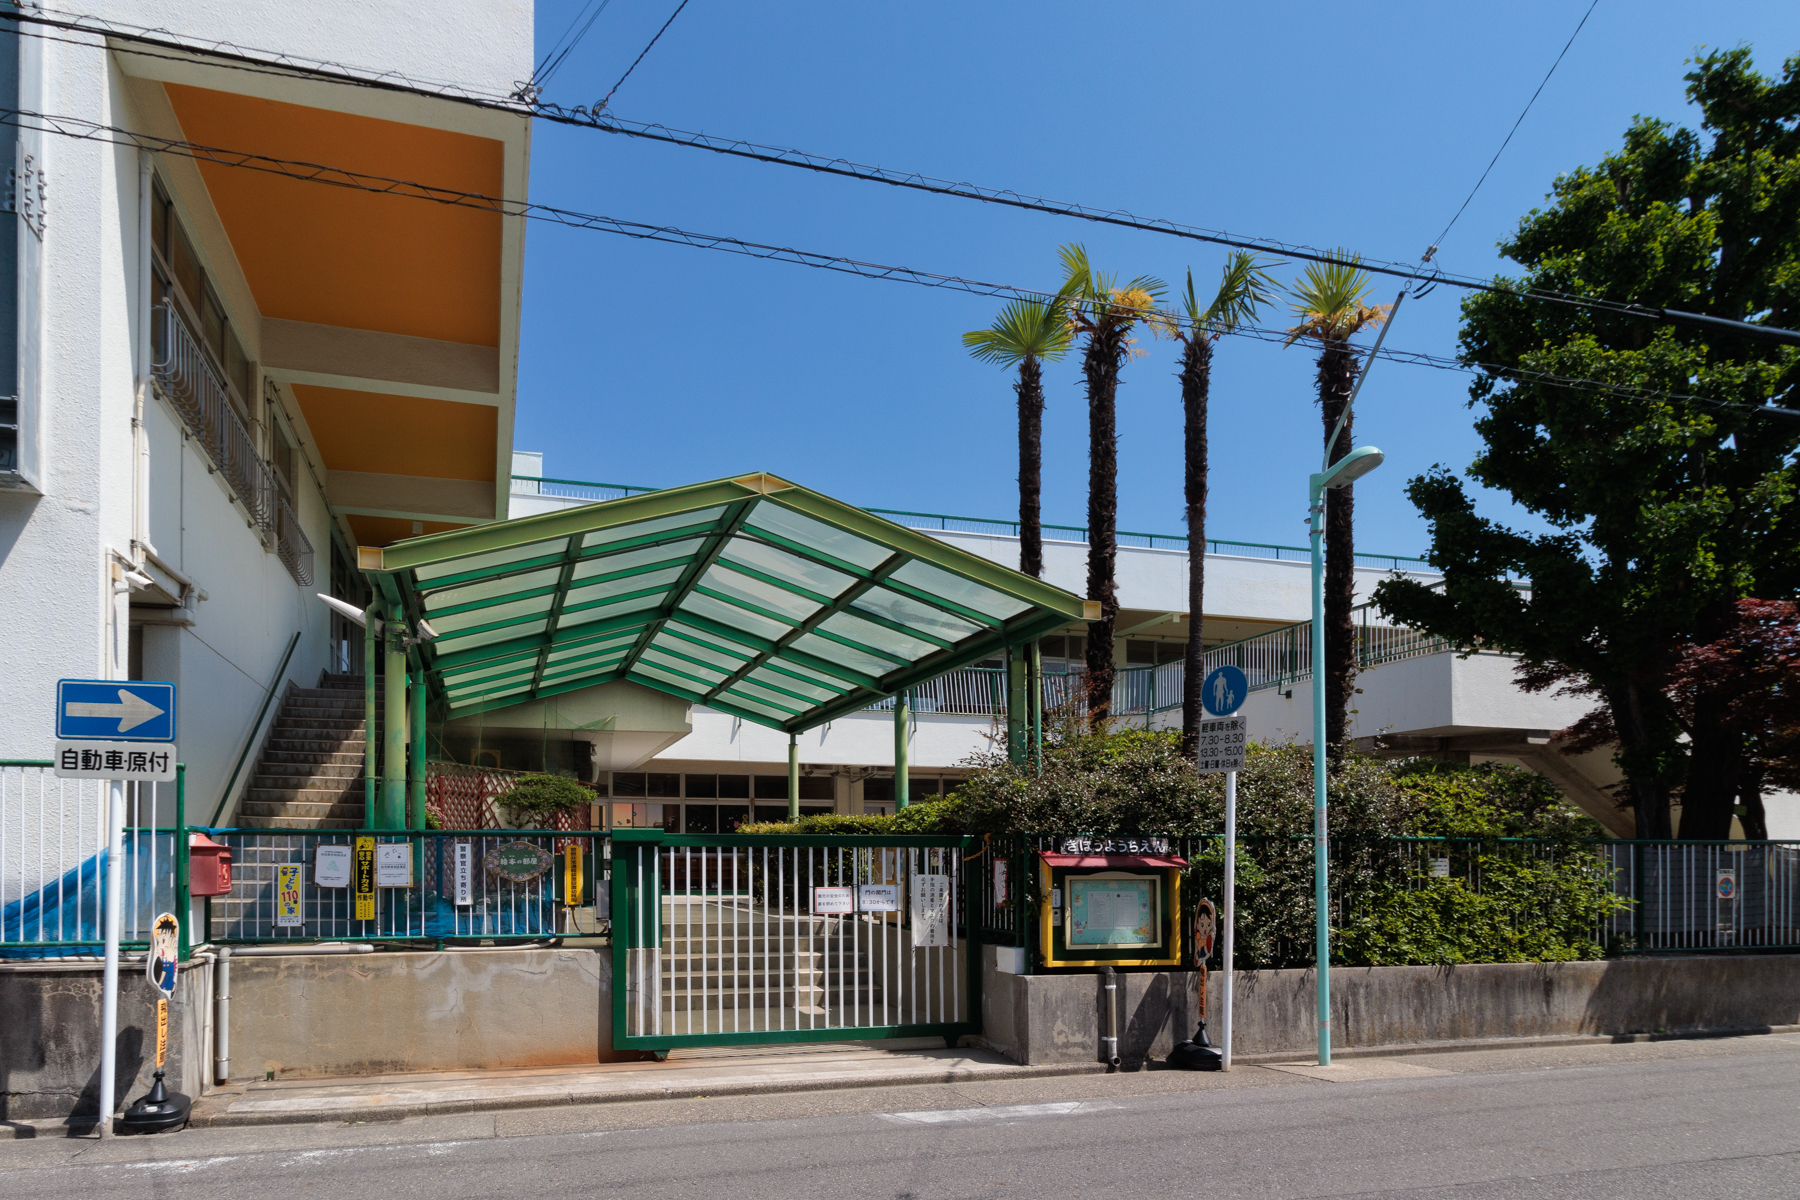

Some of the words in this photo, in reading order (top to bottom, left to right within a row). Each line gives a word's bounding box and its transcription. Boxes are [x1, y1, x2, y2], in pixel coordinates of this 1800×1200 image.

[1201, 720, 1245, 733] 軽車両を除く
[1066, 839, 1165, 853] きぼうようちえん
[500, 857, 538, 866] 絵本の部屋
[360, 861, 370, 893] サポートカメラ
[459, 845, 467, 903] 警察官立ち寄り所
[356, 894, 374, 902] 作動中
